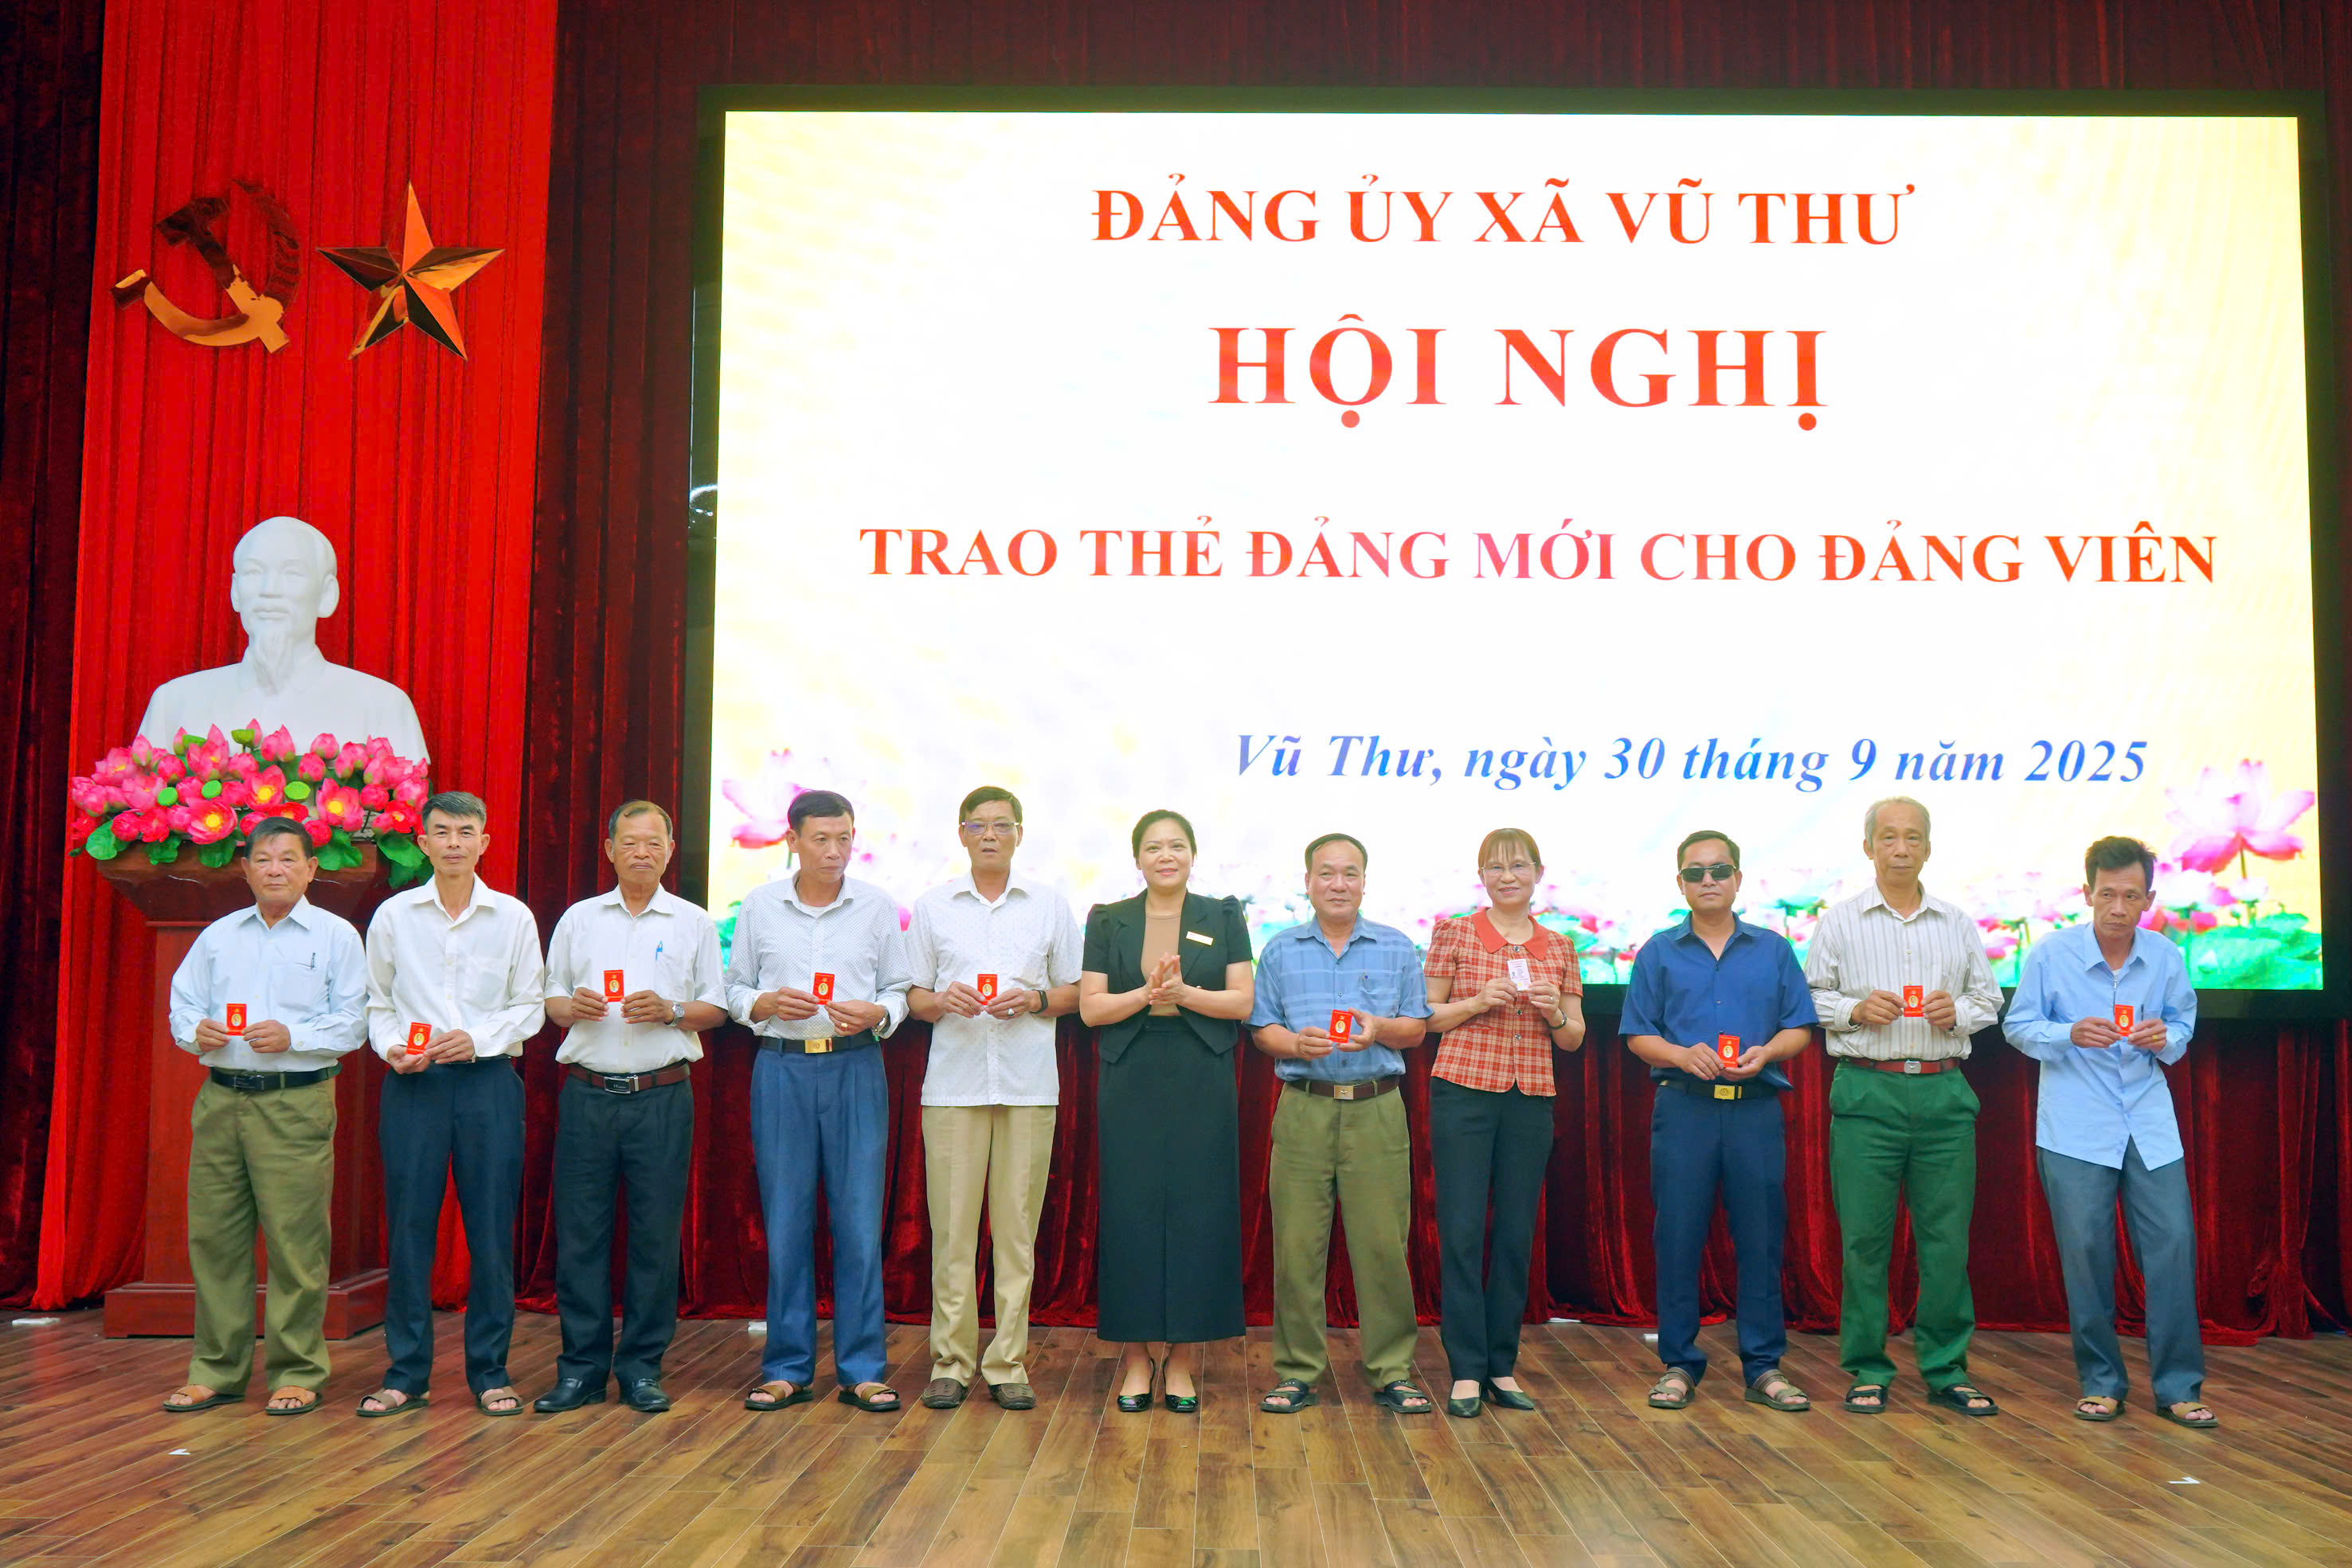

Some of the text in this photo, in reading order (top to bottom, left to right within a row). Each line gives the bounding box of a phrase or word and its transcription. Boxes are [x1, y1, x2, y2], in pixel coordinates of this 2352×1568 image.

[1092, 173, 1916, 245] ĐẢNG ỦY XÃ VŨ THƯ
[1209, 314, 1827, 432] HỘI NGHỊ
[859, 515, 2218, 583] TRAO THẺ ĐẢNG MỚI CHO ĐẢNG VIÊN
[1237, 735, 2148, 792] Vũ Thư, ngày 30 tháng 9 năm 2025
